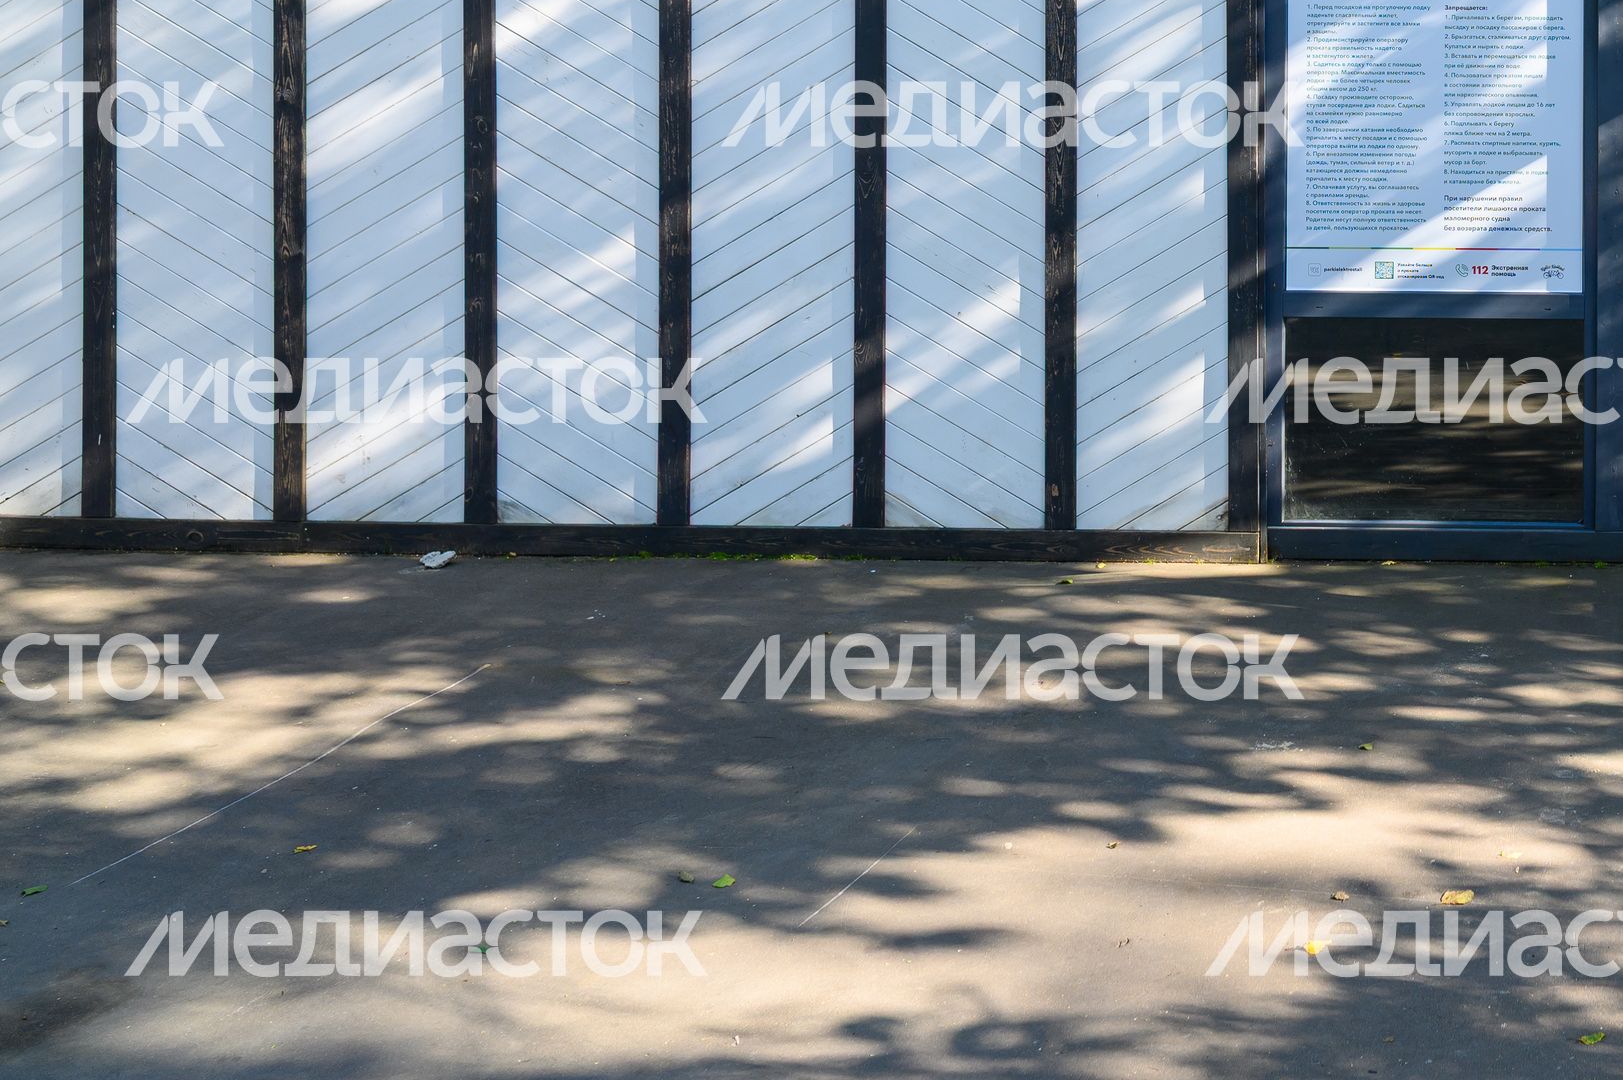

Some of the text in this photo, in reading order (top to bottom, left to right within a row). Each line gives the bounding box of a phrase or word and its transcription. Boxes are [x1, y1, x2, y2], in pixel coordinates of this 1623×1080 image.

[1444, 4, 1488, 12] Запрещается:
[1444, 195, 1523, 203] При нарушении правил
[1491, 216, 1511, 224] судна
[1456, 224, 1488, 233] возврата
[1488, 224, 1523, 233] денежных
[1524, 224, 1553, 233] средств.
[1472, 266, 1488, 274] 112
[1491, 264, 1528, 272] Экстренная
